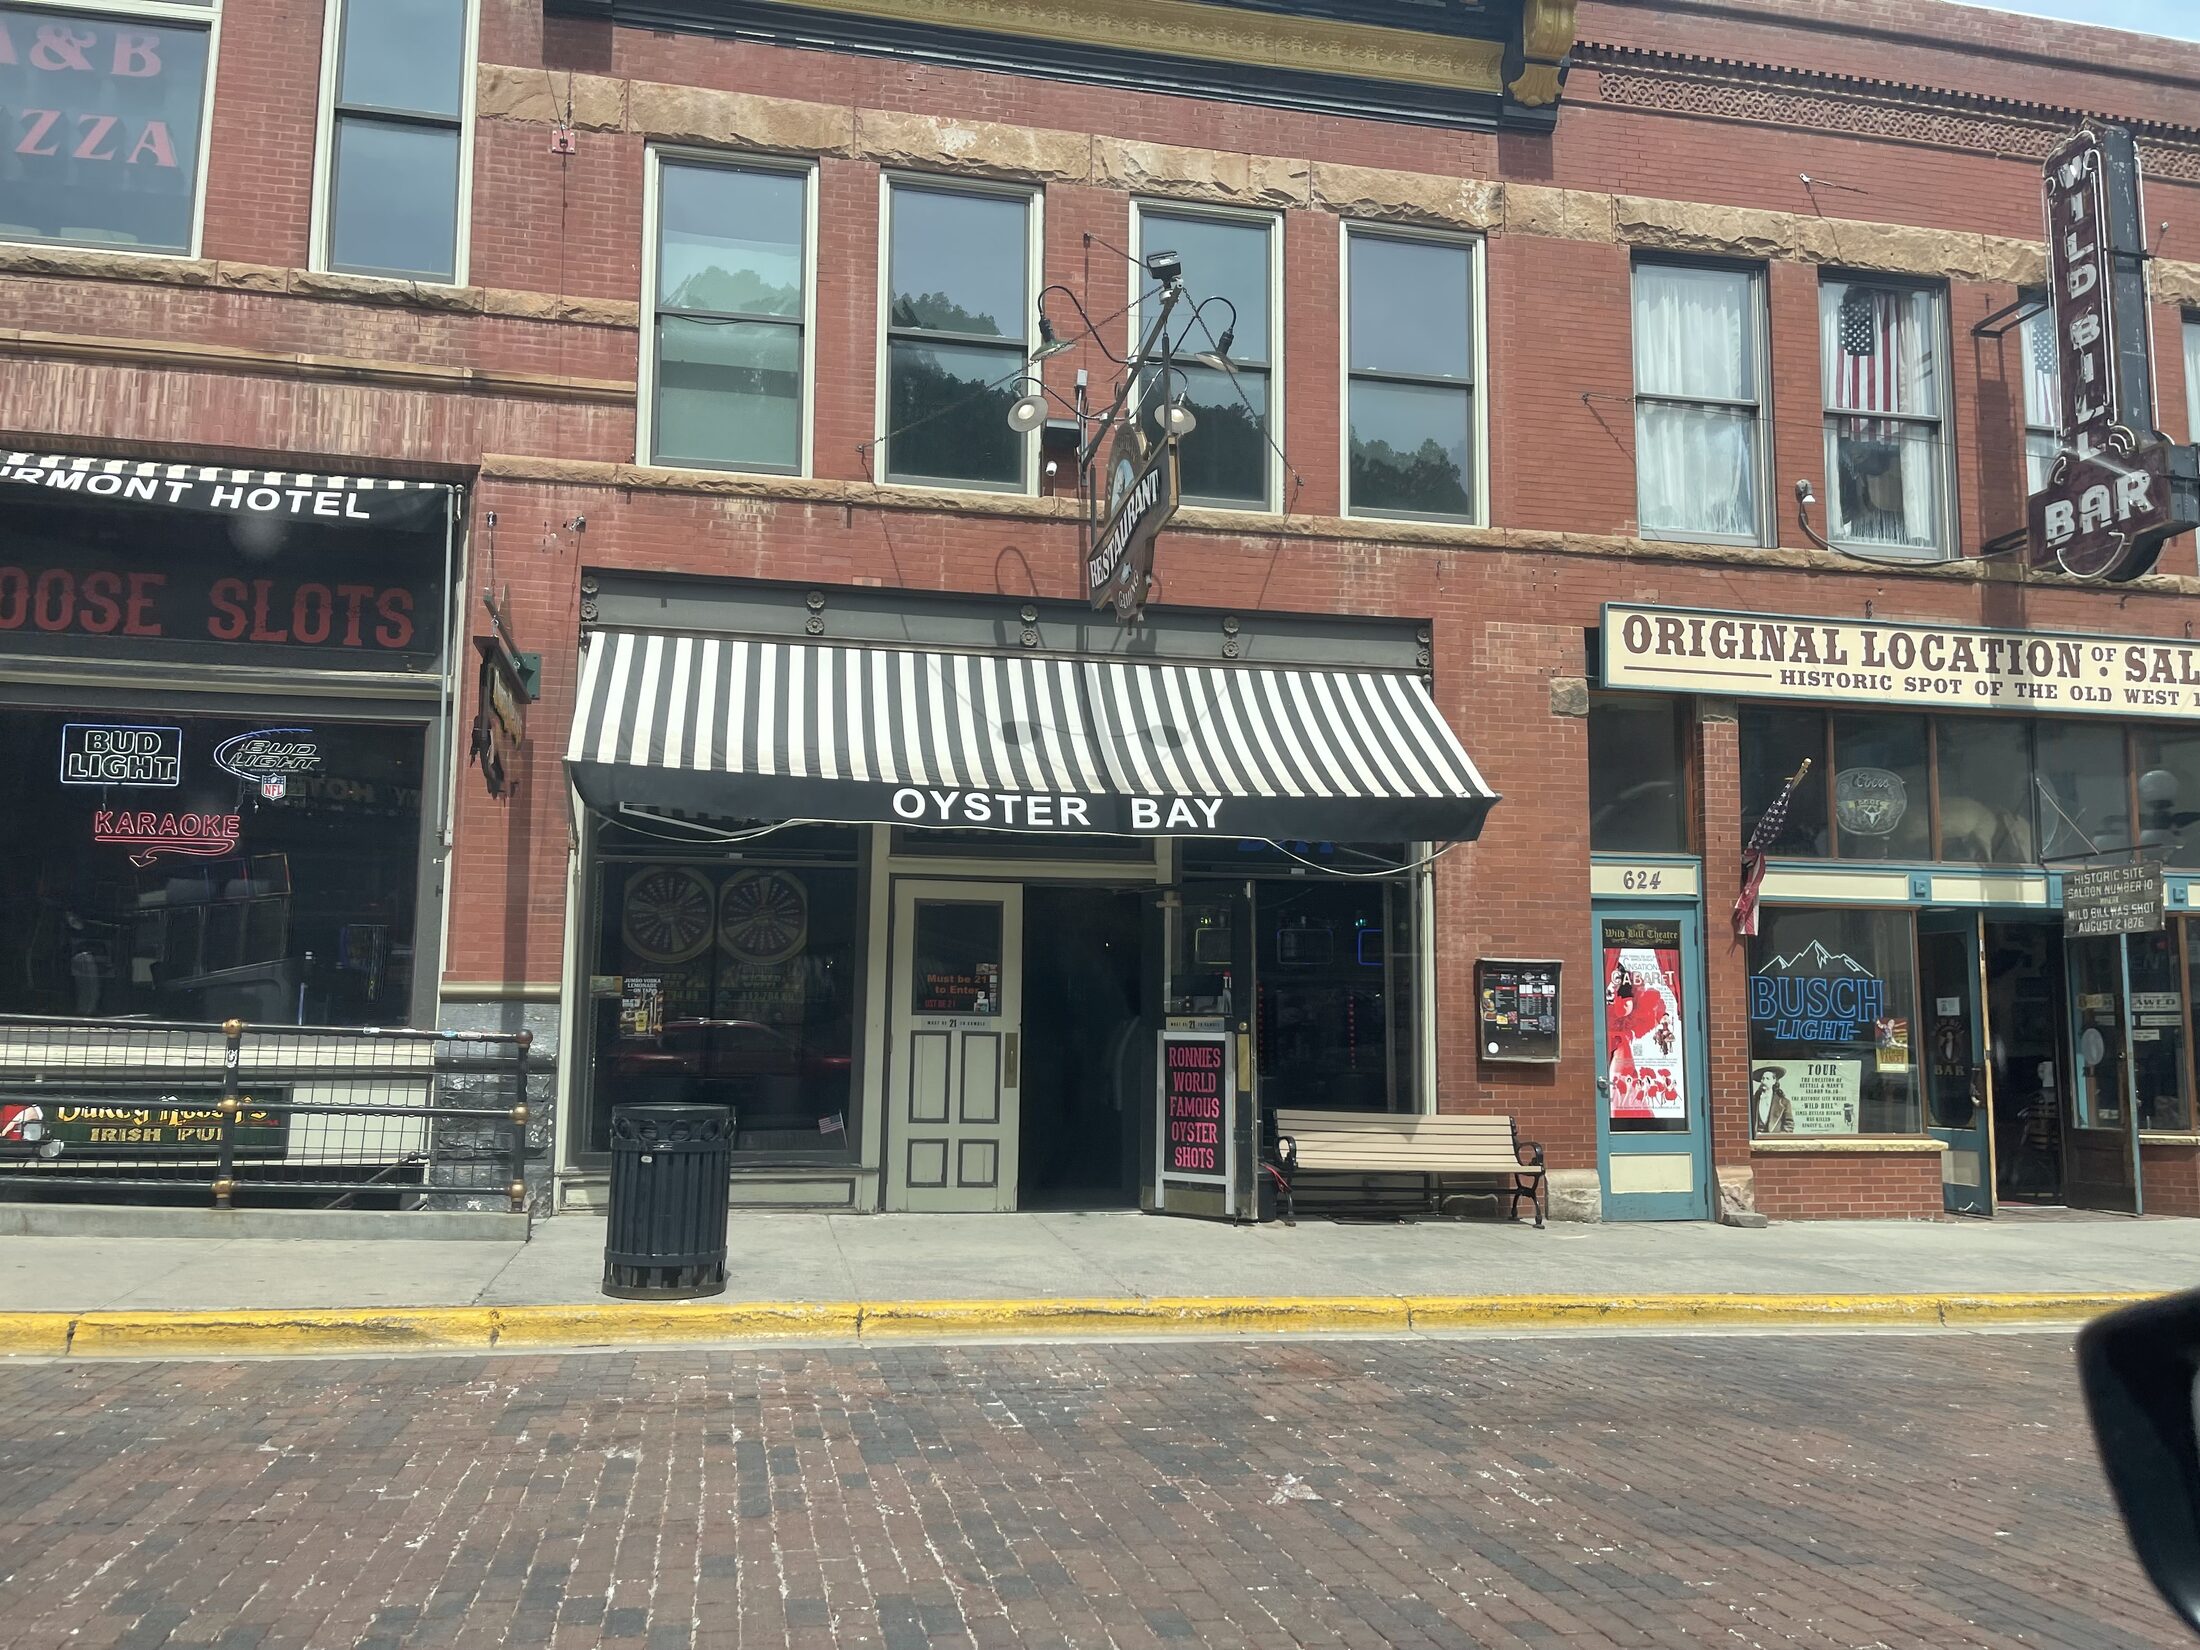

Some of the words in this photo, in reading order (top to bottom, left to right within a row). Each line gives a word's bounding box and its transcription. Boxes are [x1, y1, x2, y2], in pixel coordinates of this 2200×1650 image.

[2057, 158, 2098, 301] WILD
[2070, 313, 2107, 462] BILL
[210, 485, 371, 520] HOTEL
[2044, 467, 2155, 548] BAR
[1089, 468, 1160, 588] RESTAURANT
[1117, 569, 1140, 610] GAMING
[207, 577, 415, 648] SLOTS
[1622, 613, 1848, 668] ORIGINAL
[1859, 629, 2082, 679] LOCATION
[2091, 646, 2117, 662] OF
[1779, 669, 1893, 692] HISTORIC
[1903, 674, 1963, 696] SPOT
[1974, 680, 2004, 697] OF
[2013, 682, 2058, 702] THE
[2070, 686, 2112, 703] OLD
[2123, 688, 2180, 706] WEST
[84, 729, 163, 755] BUD
[244, 739, 317, 756] BUD
[68, 753, 178, 781] LIGHT
[228, 752, 321, 770] LIGHT
[264, 784, 284, 797] NFL
[892, 787, 1092, 827] OYSTER
[1130, 797, 1224, 830] BAY
[94, 809, 241, 839] KARAOKE
[1623, 869, 1662, 890] 624
[2073, 869, 2120, 885] HISTORIC
[2122, 866, 2145, 880] SITE
[2067, 885, 2102, 899] SALOON
[2104, 881, 2142, 895] NUMBER
[2143, 879, 2153, 891] 10
[2068, 908, 2089, 921] WILD
[2090, 906, 2110, 919] BILL
[2110, 904, 2129, 917] WAS
[2131, 901, 2155, 915] SHOT
[1604, 928, 1626, 939] Wild
[1647, 929, 1679, 940] Theatre
[2078, 919, 2113, 933] AUGUST
[2115, 918, 2122, 930] 2
[2123, 916, 2145, 929] 1876
[927, 974, 956, 984] Must
[957, 974, 972, 984] be
[935, 985, 946, 994] to
[1749, 975, 1884, 1023] BUSCH
[949, 1018, 957, 1028] 21
[1188, 1020, 1196, 1029] 21
[1775, 1018, 1855, 1041] LIGHT
[1168, 1047, 1221, 1069] RONNIES
[1807, 1064, 1838, 1076] TOUR
[1934, 1065, 1965, 1076] BAR
[1173, 1071, 1217, 1093] WORLD
[1169, 1096, 1220, 1119] FAMOUS
[90, 1127, 162, 1142] IRISH
[177, 1127, 225, 1142] PU
[1171, 1121, 1218, 1144] OYSTER
[1174, 1146, 1215, 1169] SHOTS
